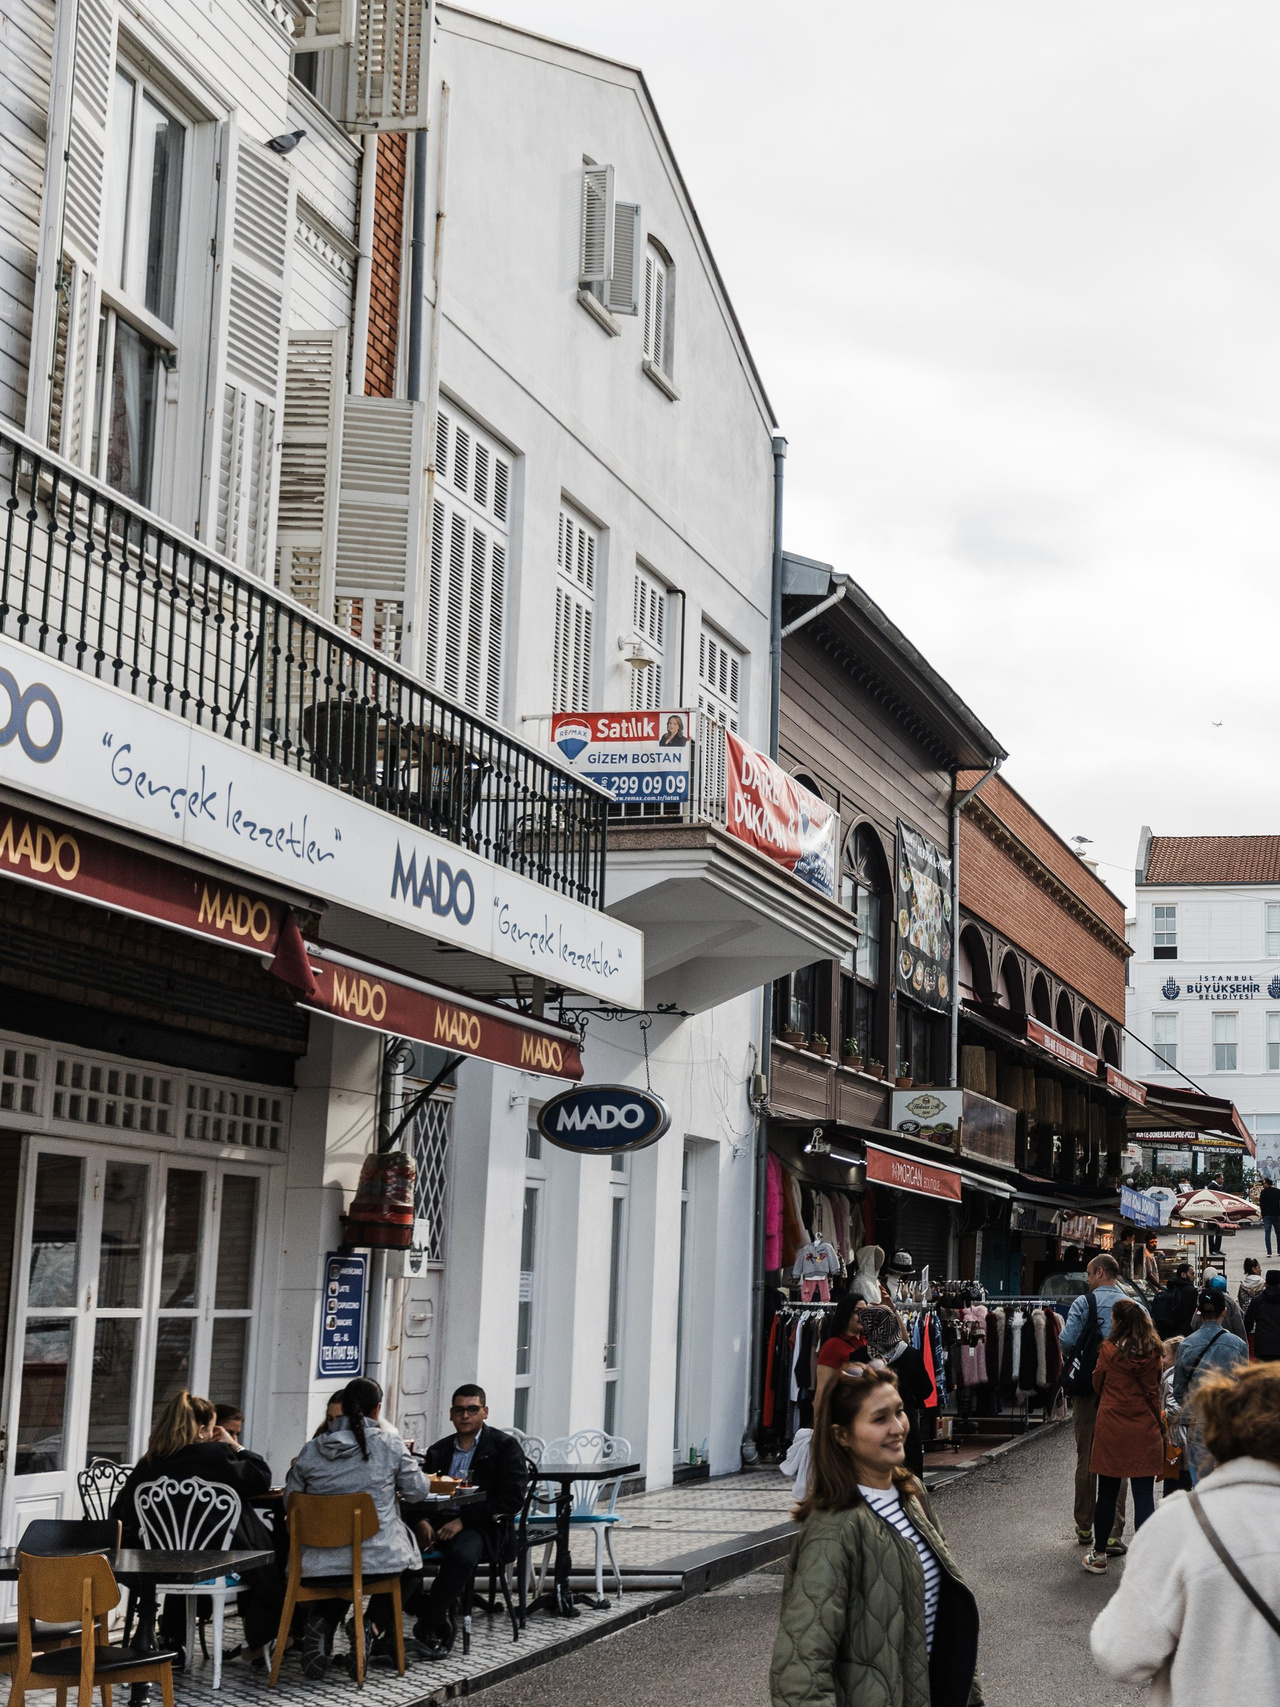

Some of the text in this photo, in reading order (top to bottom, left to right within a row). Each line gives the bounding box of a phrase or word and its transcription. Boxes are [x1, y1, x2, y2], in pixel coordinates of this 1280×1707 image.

[560, 729, 587, 737] RE/MAX
[596, 717, 656, 739] Satılık
[588, 752, 682, 764] GİZEM BOSTAN
[610, 776, 639, 795] 299
[642, 776, 662, 795] 09
[665, 775, 686, 795] 09
[741, 754, 779, 807] DAİRE
[734, 793, 788, 853] DÜKKAN
[391, 839, 475, 925] MADO
[198, 883, 271, 943] MADO
[332, 971, 387, 1022] MADO
[1186, 982, 1260, 994] BÜYÜKŞEHİR
[433, 1006, 481, 1050] MADO
[520, 1033, 563, 1072] MADO
[556, 1104, 645, 1132] MADO
[897, 1163, 922, 1188] MORGAN
